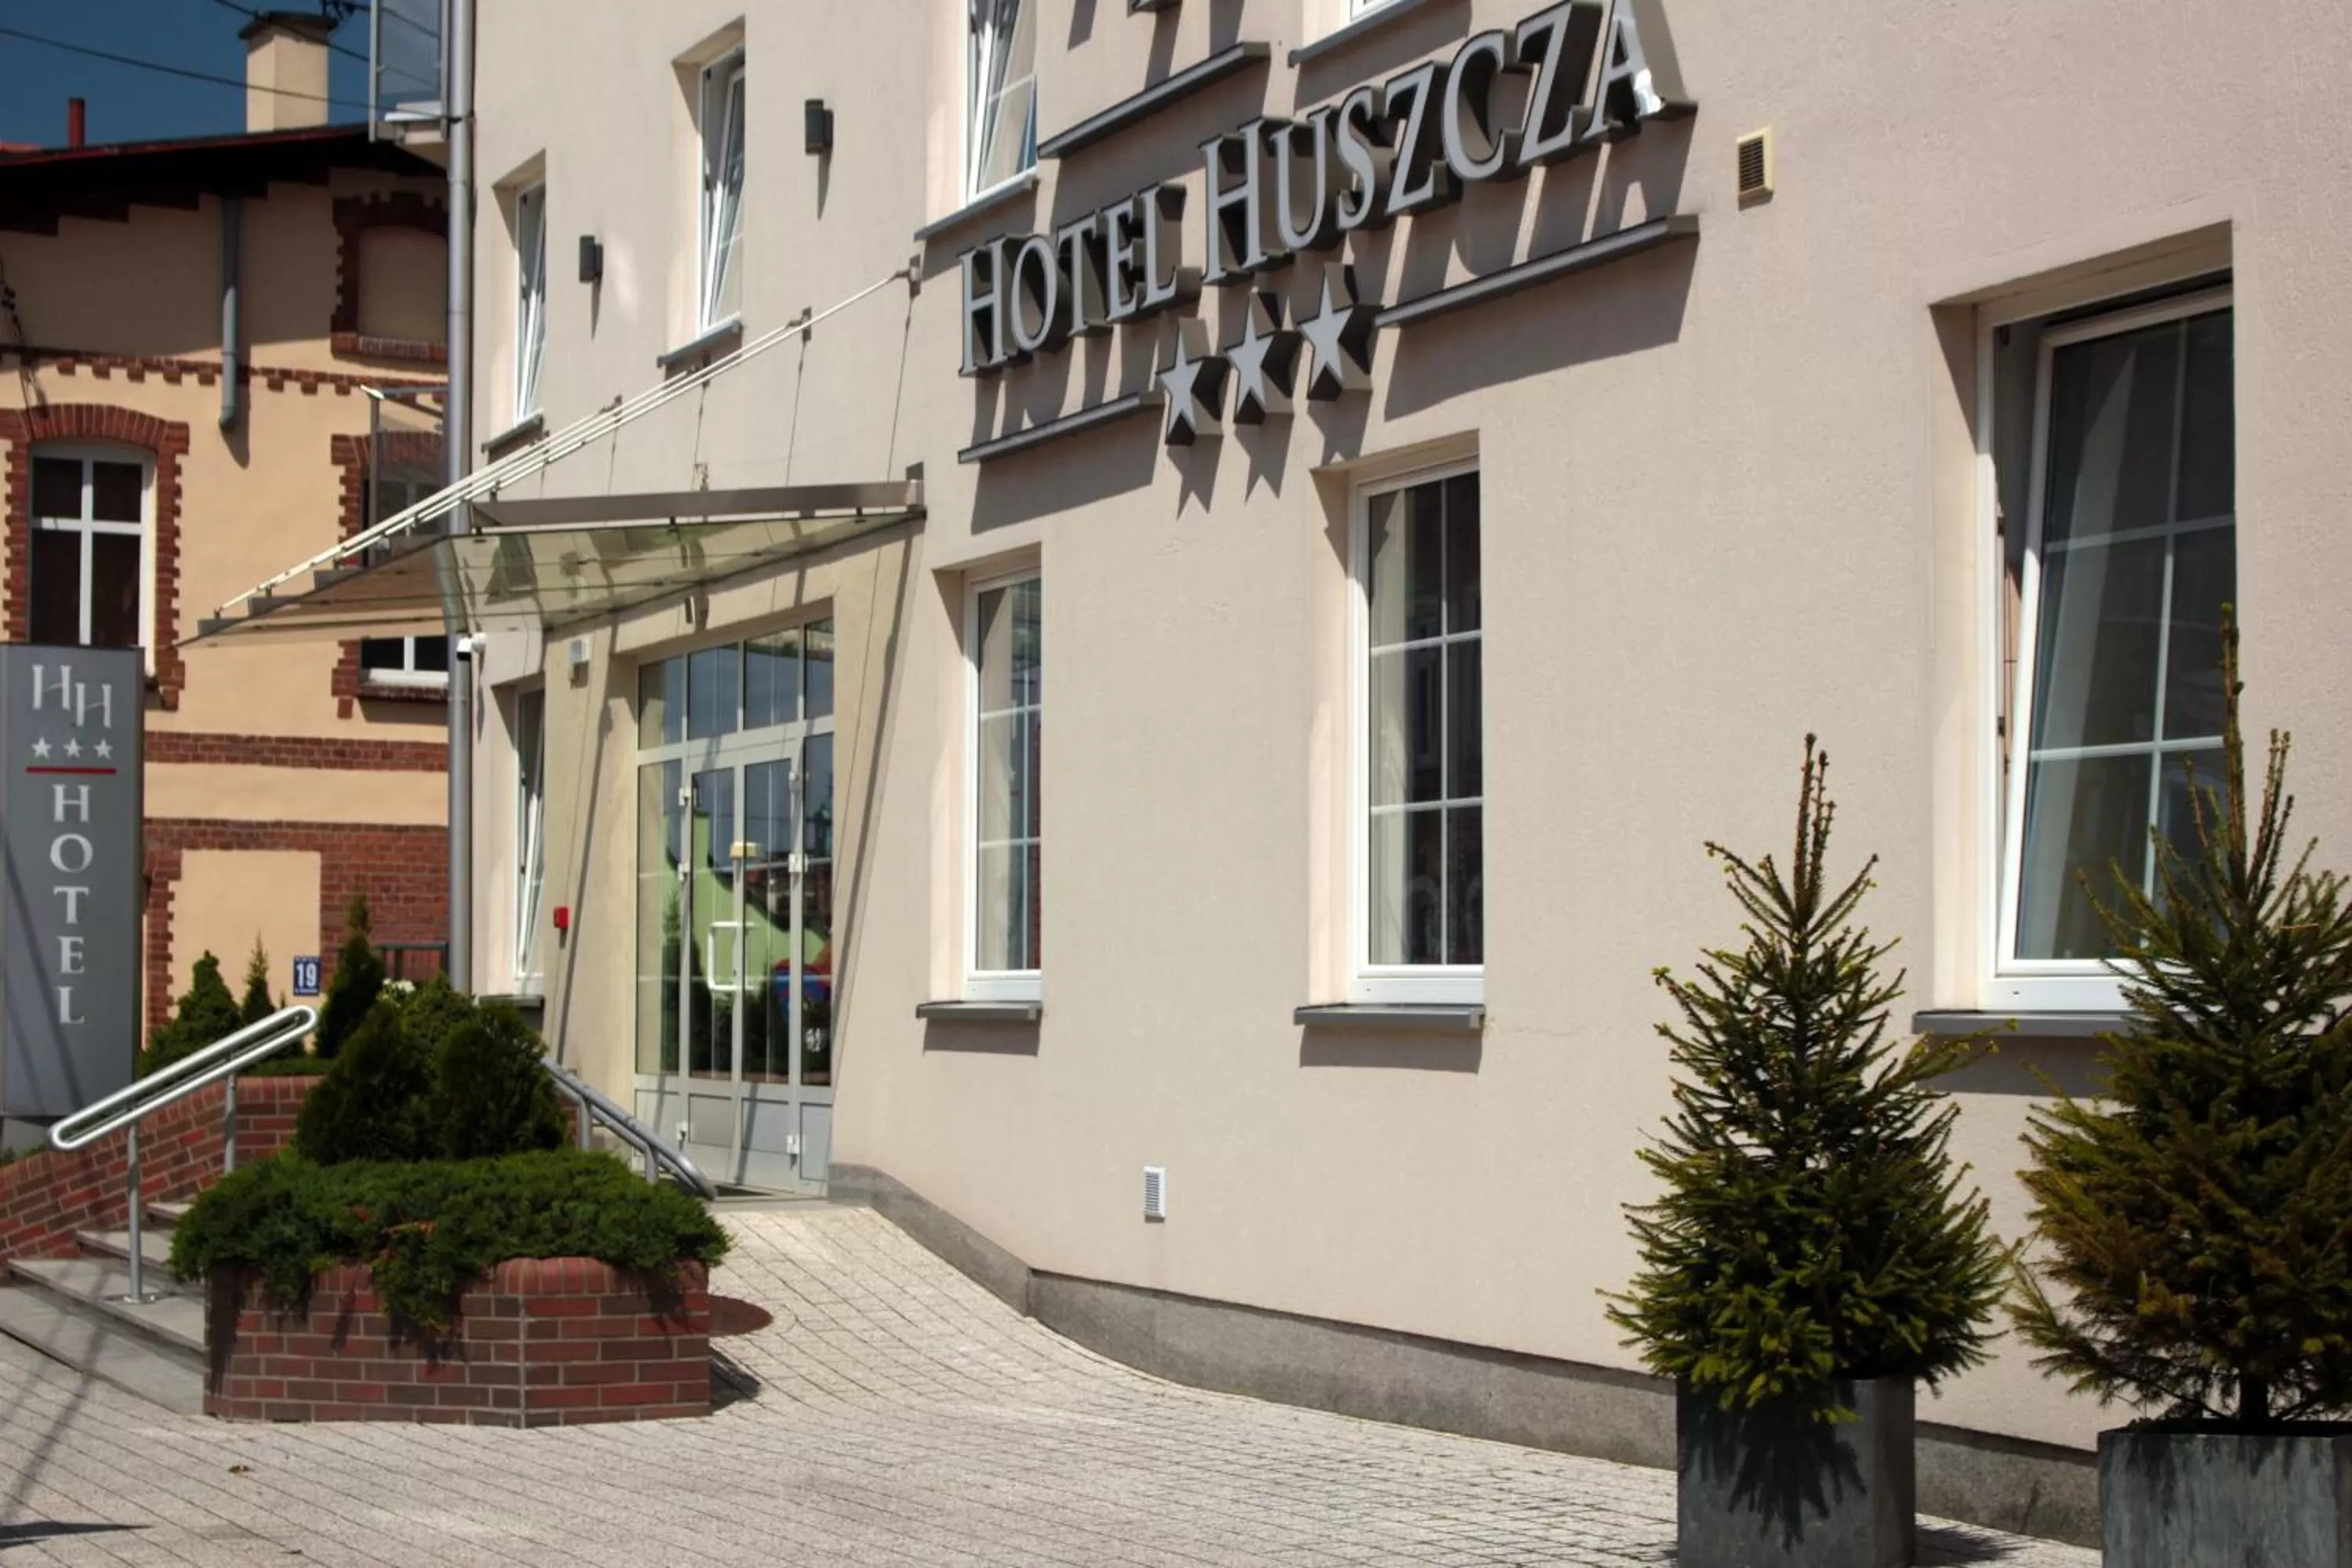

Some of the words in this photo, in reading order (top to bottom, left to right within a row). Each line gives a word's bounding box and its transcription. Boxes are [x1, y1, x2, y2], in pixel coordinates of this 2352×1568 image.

[958, 185, 1178, 376] HOTEL
[1198, 0, 1665, 284] HUSZCZA
[49, 784, 94, 1025] HOTEL
[296, 963, 317, 988] 19
